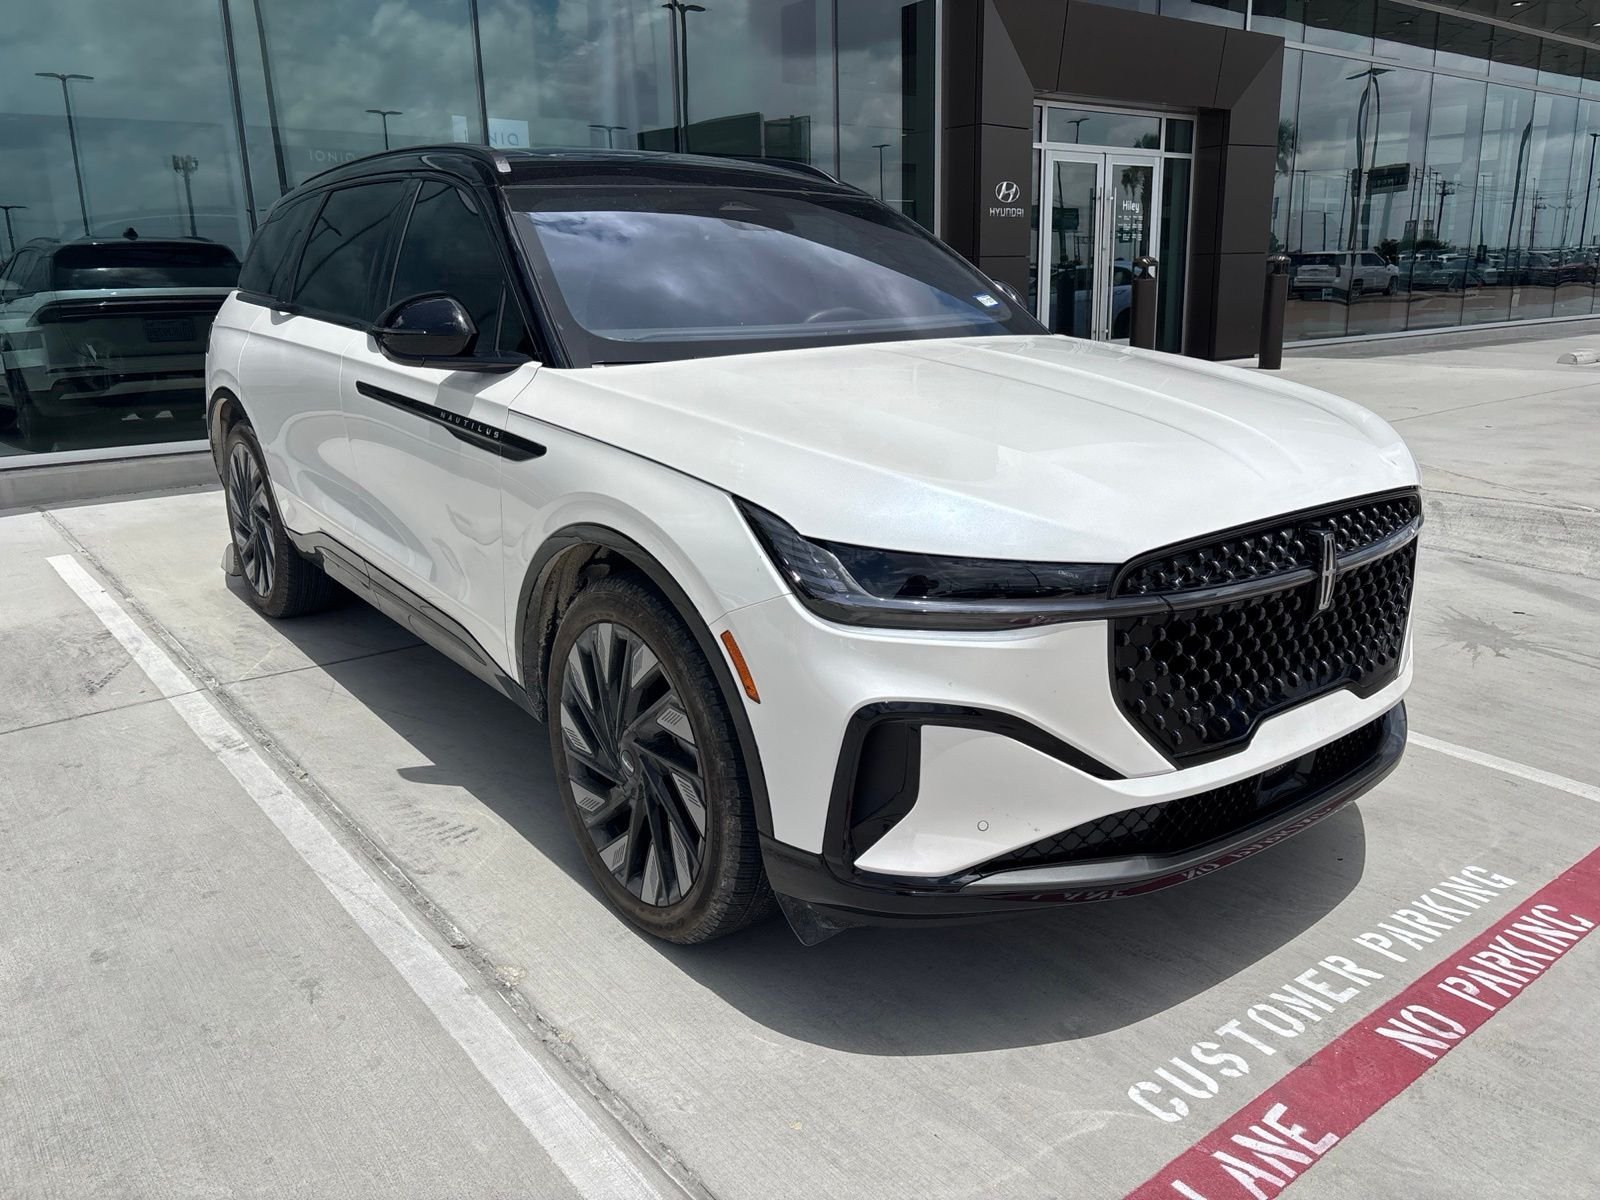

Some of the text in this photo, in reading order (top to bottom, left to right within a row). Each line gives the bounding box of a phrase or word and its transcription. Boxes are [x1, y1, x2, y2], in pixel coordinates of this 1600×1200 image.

[989, 207, 1024, 217] HYUNDAI
[1122, 200, 1140, 213] Hiley
[440, 411, 500, 439] NAUTILUS
[1127, 865, 1517, 1123] CUSTOMER PARKING
[1374, 1004, 1467, 1060] NO
